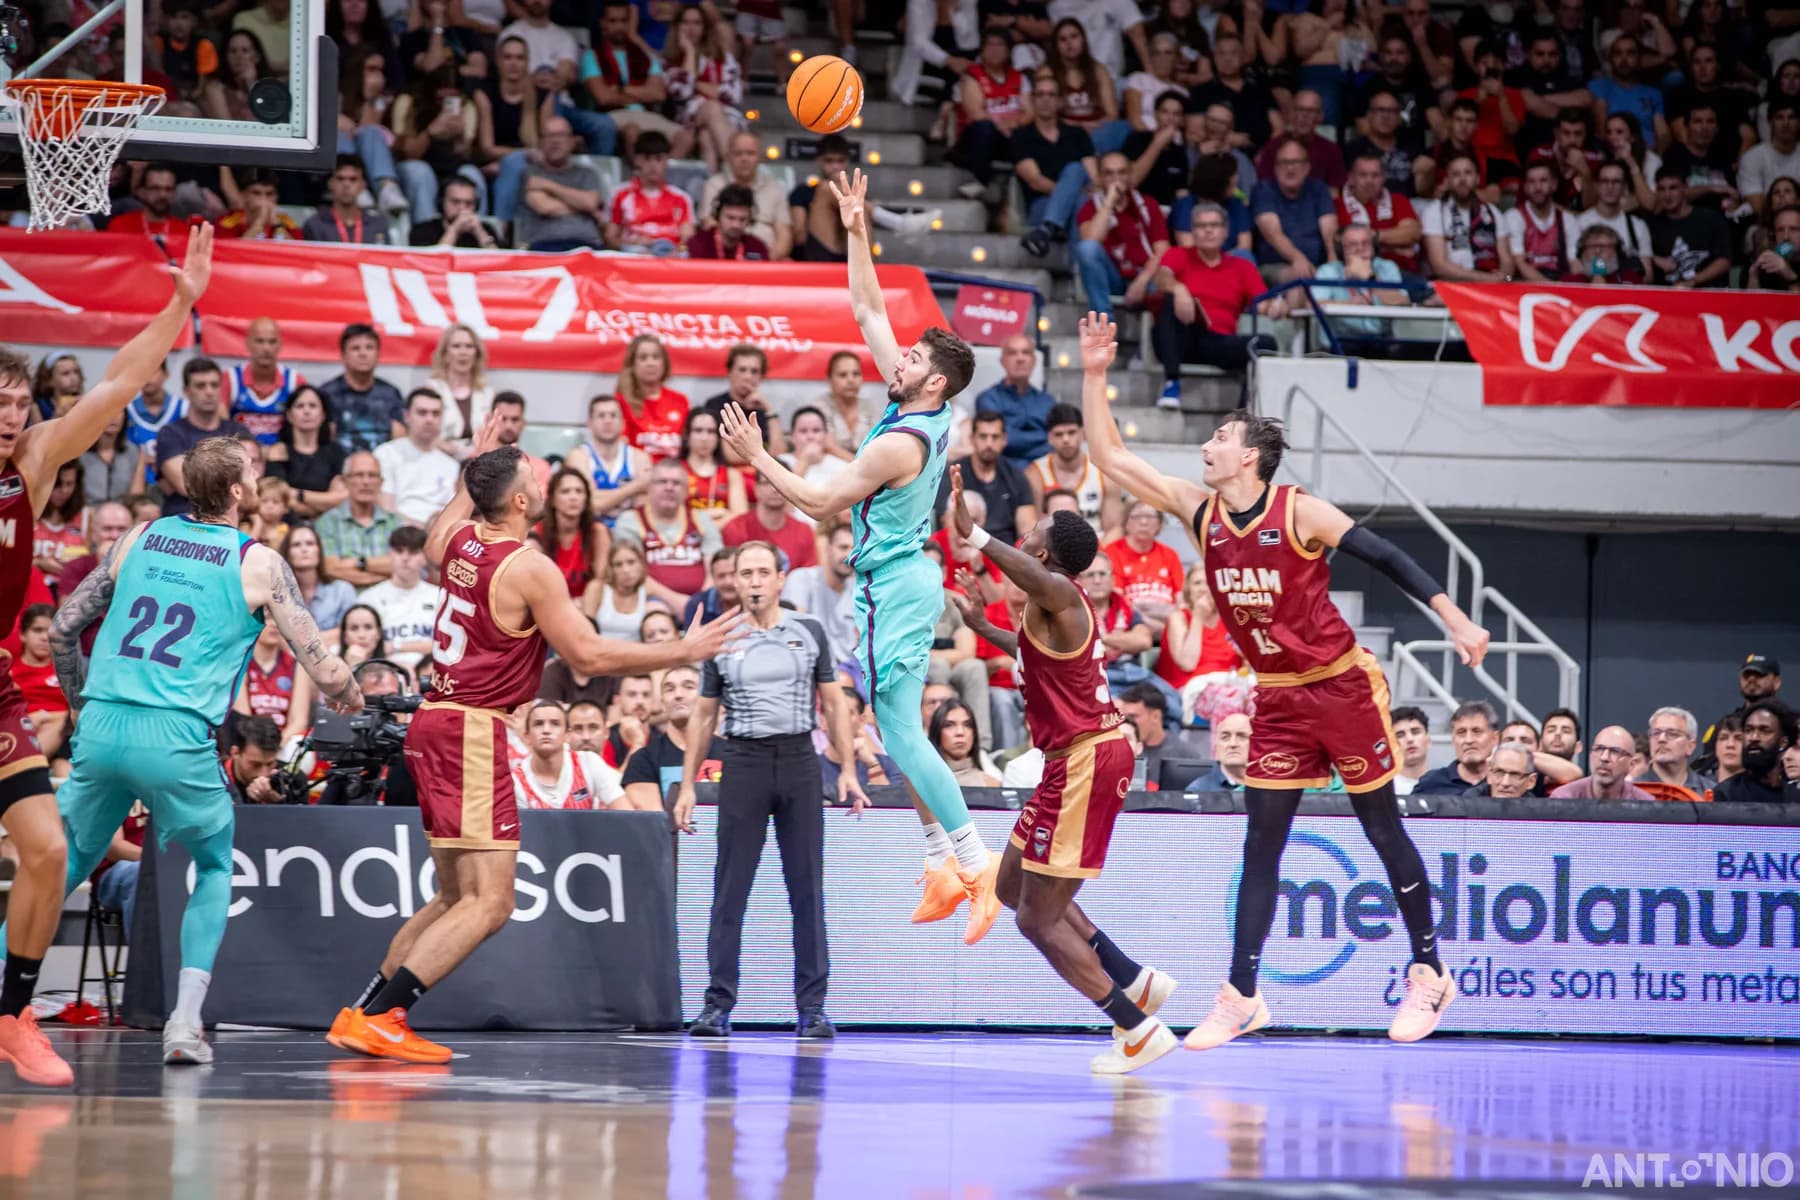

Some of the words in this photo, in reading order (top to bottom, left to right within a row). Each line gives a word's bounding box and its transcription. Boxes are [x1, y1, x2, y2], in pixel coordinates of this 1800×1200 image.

[585, 309, 742, 335] AGENCIA
[746, 315, 795, 337] DE
[143, 533, 231, 568] BALCEROWSKI
[1214, 566, 1283, 595] UCAM
[118, 595, 196, 669] 22
[1551, 967, 1617, 1001] son
[1631, 961, 1687, 1001] tus
